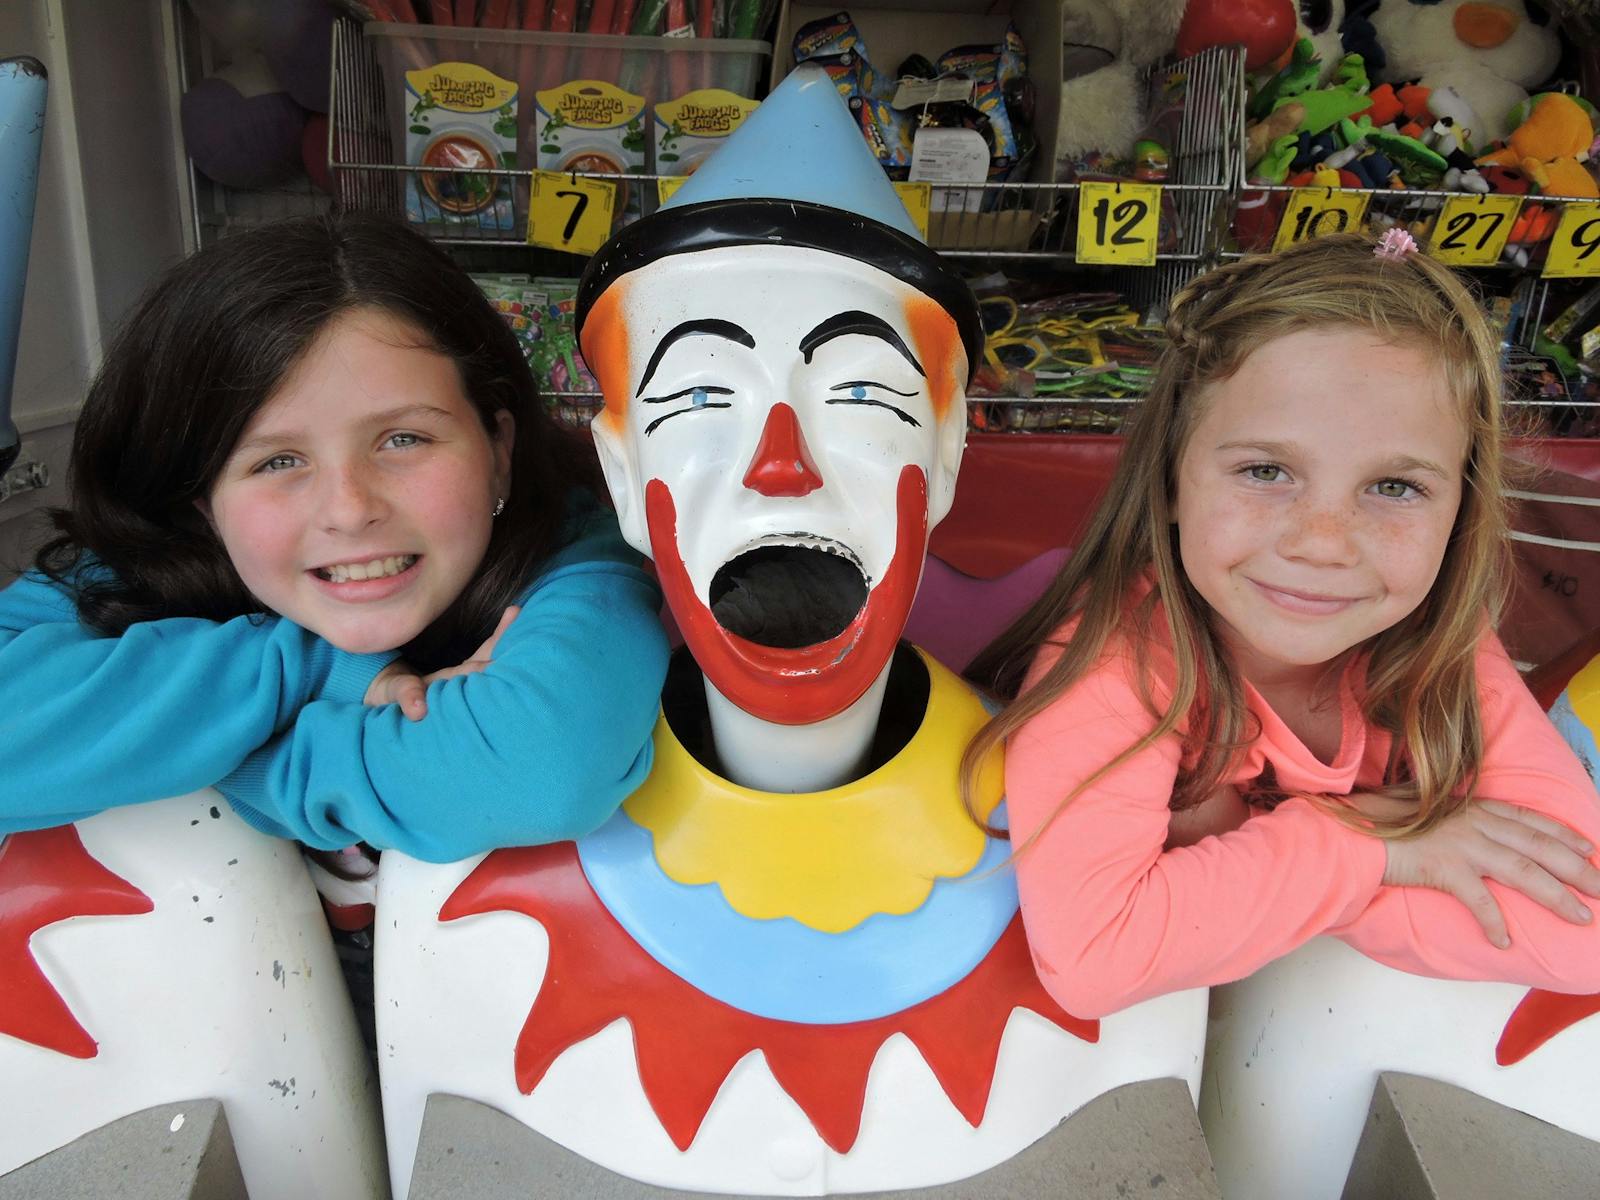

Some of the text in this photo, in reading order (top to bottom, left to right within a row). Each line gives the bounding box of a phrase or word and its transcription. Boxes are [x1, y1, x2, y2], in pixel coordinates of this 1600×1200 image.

[556, 190, 588, 241] 7
[1093, 199, 1148, 246] 12
[1293, 205, 1349, 242] 10
[1440, 212, 1505, 250] 27
[1571, 218, 1600, 260] 9
